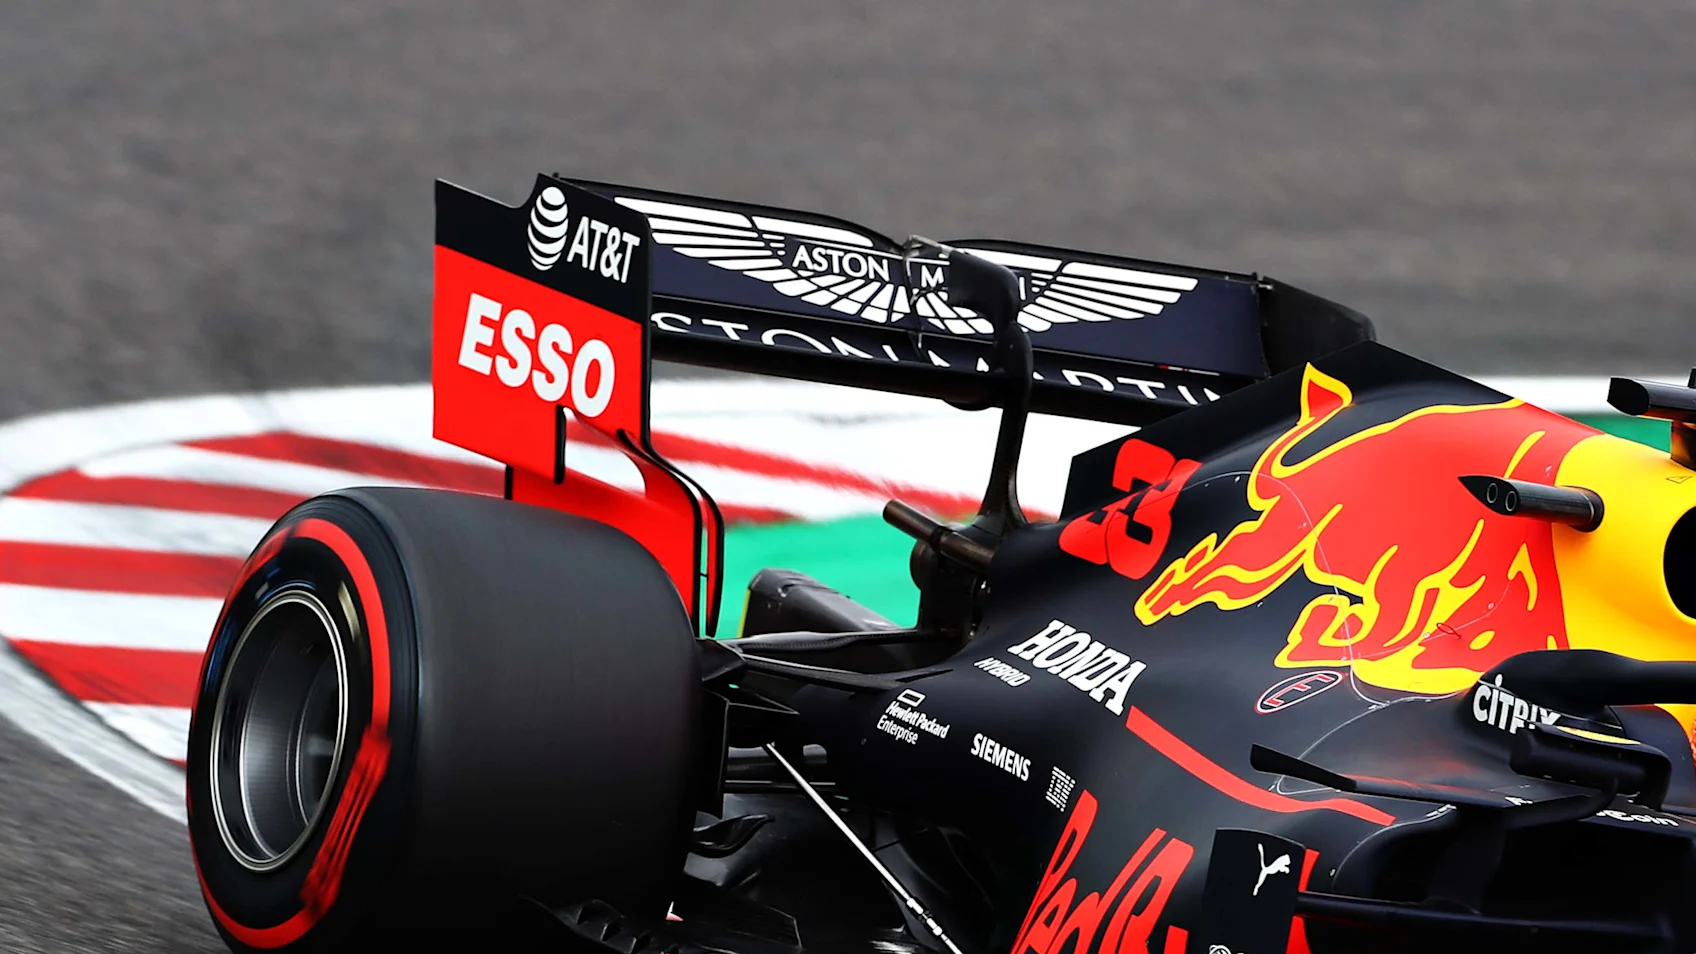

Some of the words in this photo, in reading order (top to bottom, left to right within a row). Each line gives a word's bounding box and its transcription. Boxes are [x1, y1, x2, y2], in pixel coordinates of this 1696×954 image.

[567, 215, 640, 284] AT&T
[792, 244, 889, 282] ASTON
[458, 293, 616, 418] ESSO
[973, 656, 1031, 687] HYBRID
[1007, 618, 1147, 716] HONDA
[877, 714, 918, 745] Enterprise
[885, 701, 920, 726] Hewlett
[915, 713, 950, 739] Packard
[970, 733, 1031, 781] SIEMENS
[1045, 766, 1076, 812] IBM
